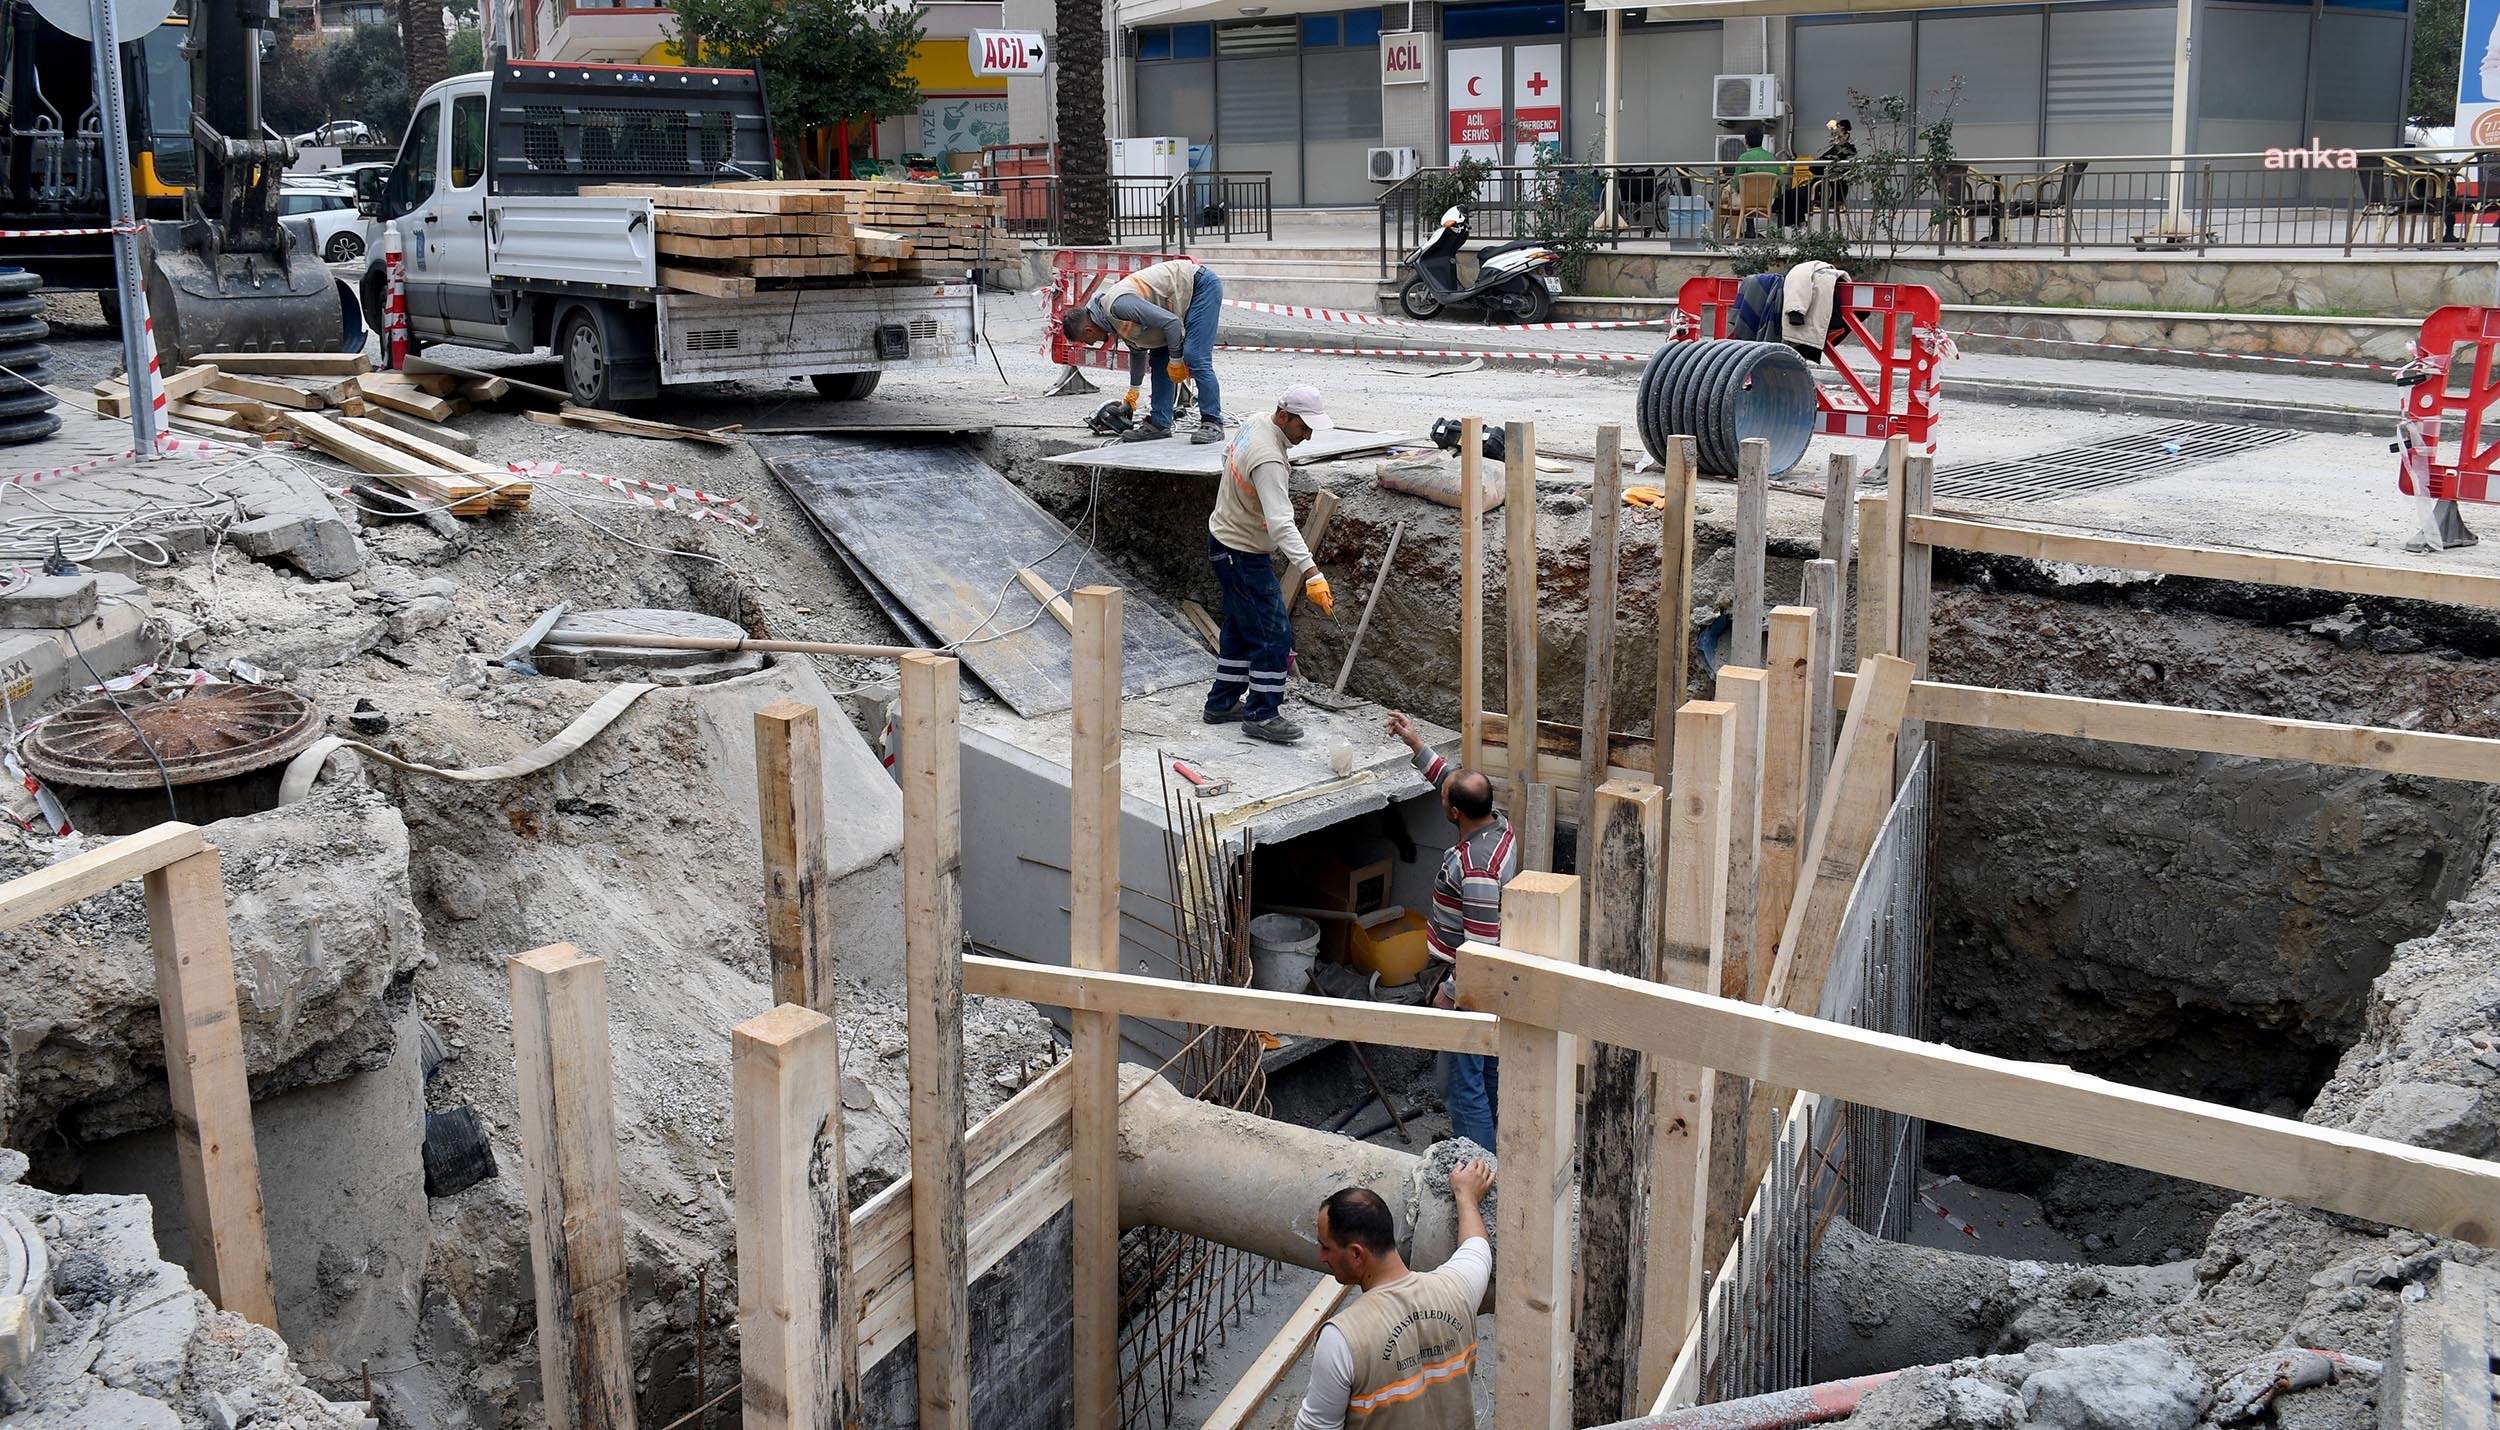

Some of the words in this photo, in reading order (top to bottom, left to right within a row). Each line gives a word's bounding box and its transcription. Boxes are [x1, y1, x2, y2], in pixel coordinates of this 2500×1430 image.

[1386, 40, 1421, 71] ACİL
[1466, 112, 1485, 127] ACİL
[1519, 120, 1557, 130] EMERGENCY
[922, 108, 936, 148] TAZE
[1462, 127, 1490, 141] SERVİS
